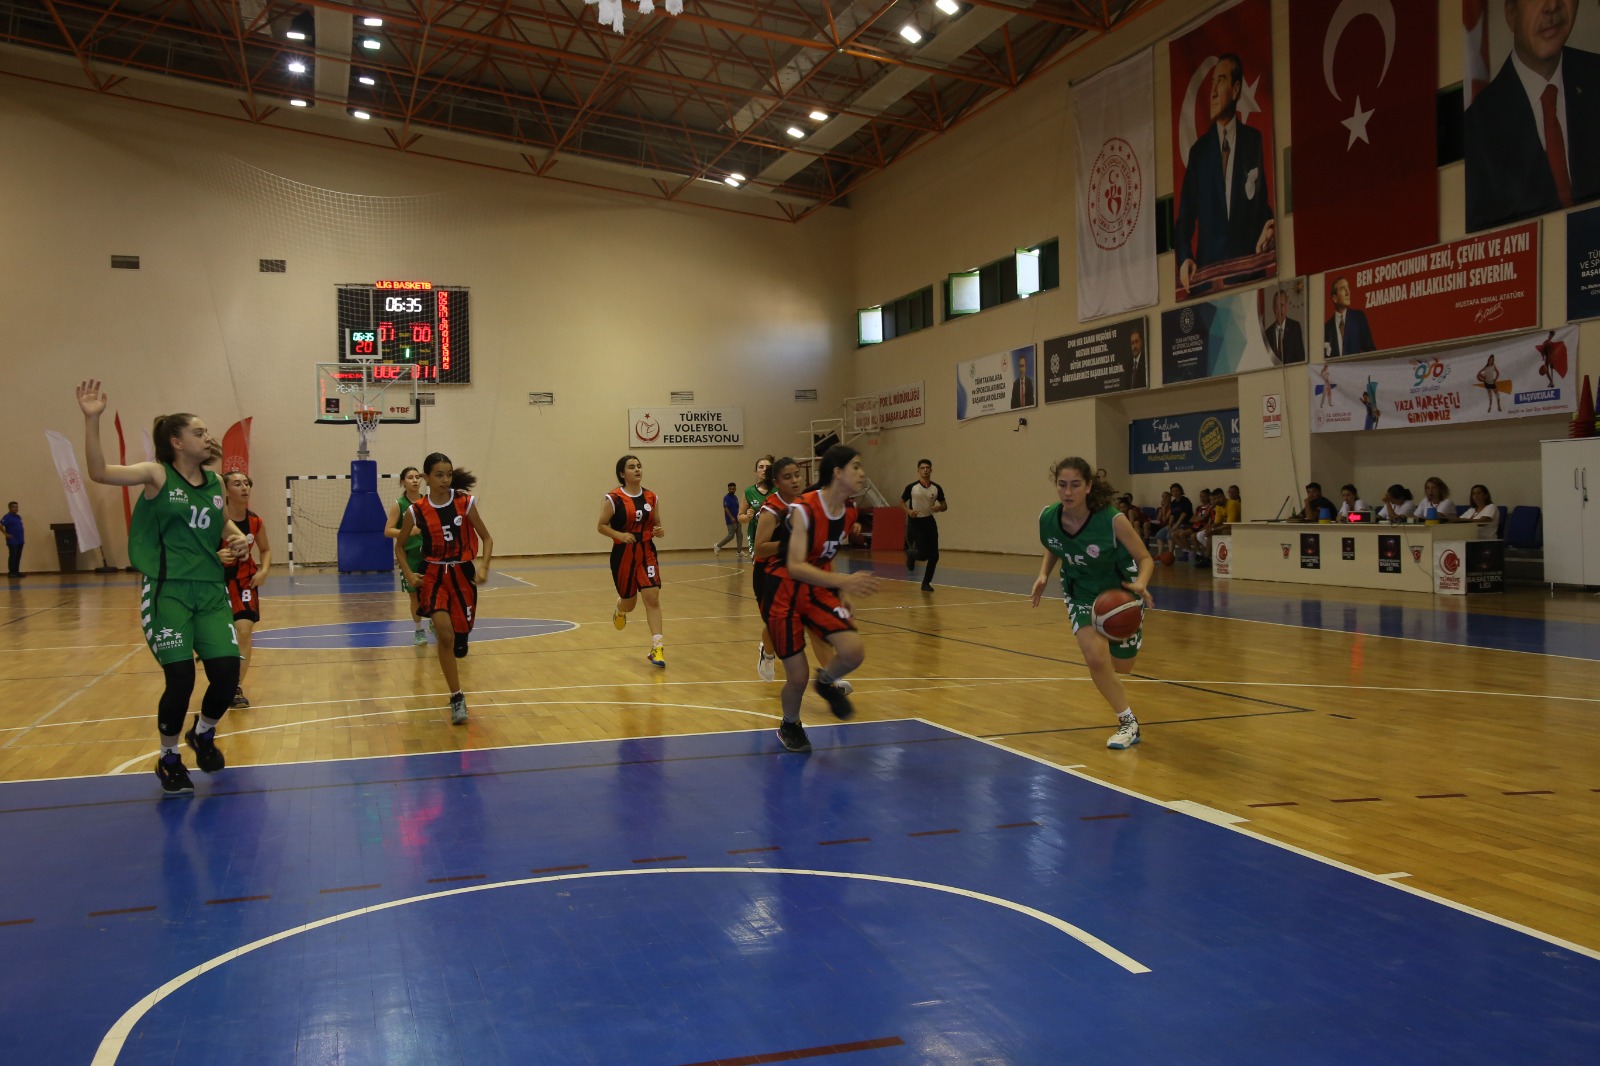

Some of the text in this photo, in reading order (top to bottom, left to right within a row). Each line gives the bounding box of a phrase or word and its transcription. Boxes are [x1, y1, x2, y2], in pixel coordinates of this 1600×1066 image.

[1357, 231, 1530, 288] BEN SPORCUNUN ZEKİ, ÇEVİK VE AYNI
[1580, 260, 1589, 270] VE
[393, 281, 432, 290] BASKETB
[1365, 258, 1517, 309] ZAMANDA AHLAKLISINI SEVERİM.
[385, 297, 422, 312] 06:35
[1455, 290, 1525, 309] MUSTAFA KEMAL ATATÜRK
[352, 332, 375, 341] 06:35
[413, 326, 431, 342] 00
[355, 341, 373, 353] 20
[1394, 391, 1461, 412] YAZA HAREKETLİ
[679, 411, 722, 422] TÜRKİYE
[909, 406, 922, 418] DİLER
[1407, 409, 1451, 424] GİRİYORUZ
[674, 423, 728, 432] VOLEYBOL
[663, 434, 739, 443] FEDERASYONU
[1162, 431, 1171, 441] EL
[1142, 440, 1192, 454] KAL-KA-MAZ!
[189, 505, 211, 529] 16
[635, 510, 643, 521] 9
[443, 525, 453, 541] 5
[647, 565, 655, 577] 9
[242, 589, 251, 602] 8
